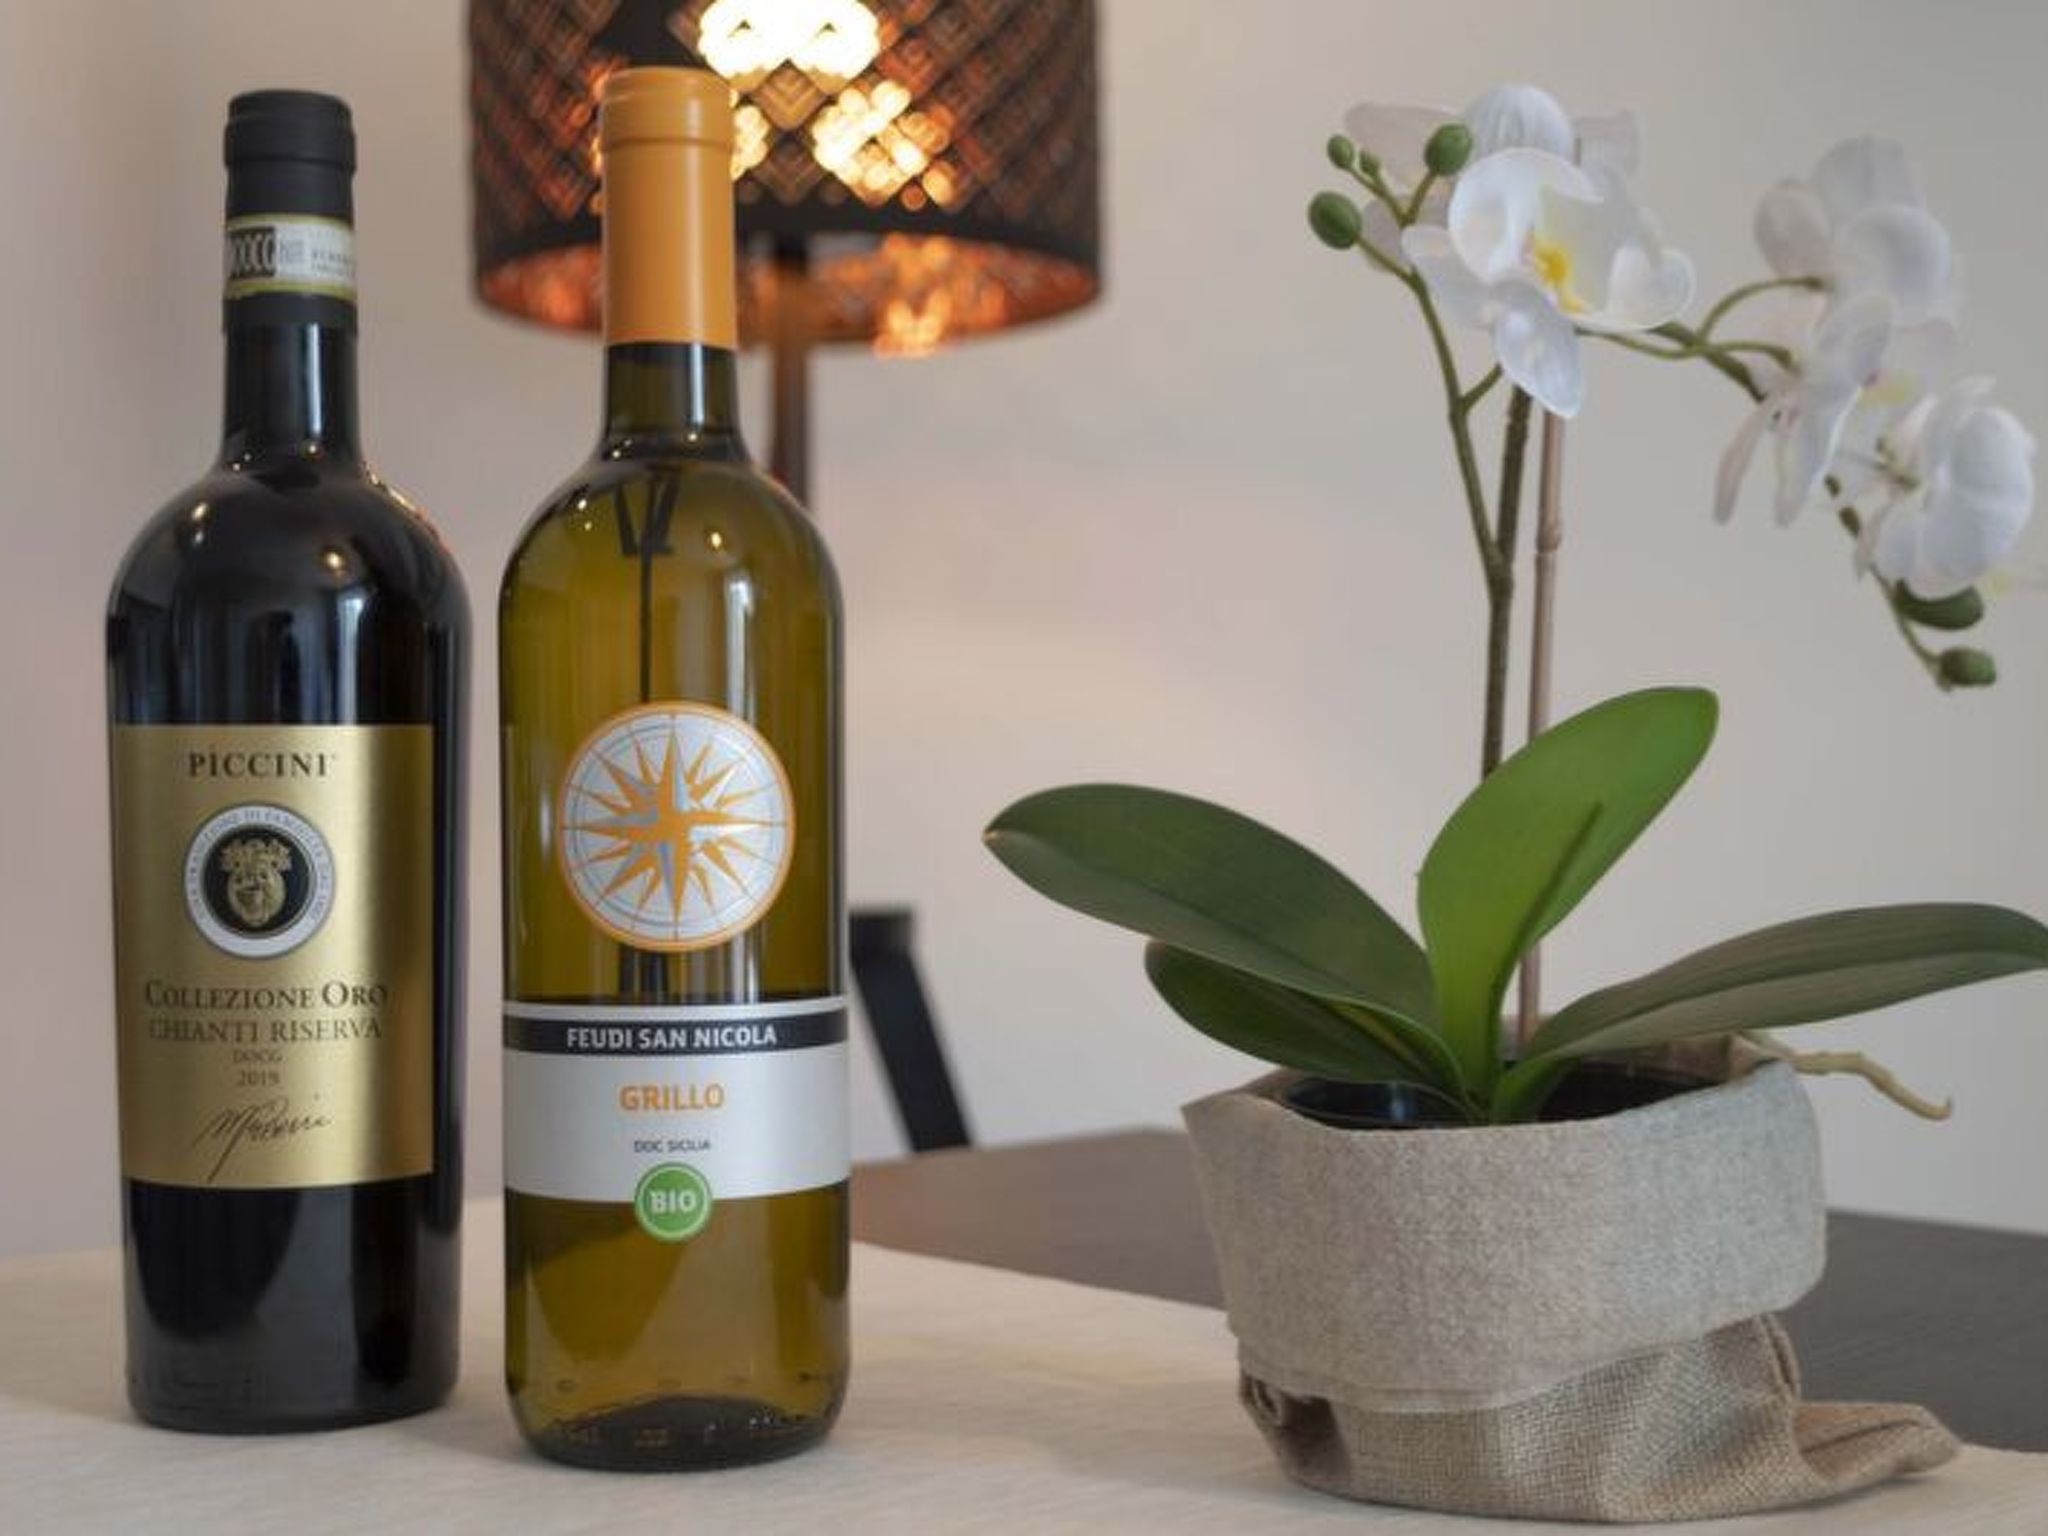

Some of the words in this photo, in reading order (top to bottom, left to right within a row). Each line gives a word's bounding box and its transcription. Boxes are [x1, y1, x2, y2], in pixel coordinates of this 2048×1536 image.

[188, 753, 327, 777] PICCINI
[146, 981, 315, 1010] COLLEZIONE
[321, 980, 389, 1009] ORO
[149, 1019, 258, 1043] CHIANTI
[270, 1017, 383, 1042] RISERVA
[566, 1028, 632, 1048] FEUDI
[639, 1028, 686, 1049] SAN
[694, 1025, 777, 1048] NICOLA
[619, 1084, 725, 1111] GRILLO
[633, 1140, 664, 1153] DOC
[650, 1190, 697, 1213] BIO
